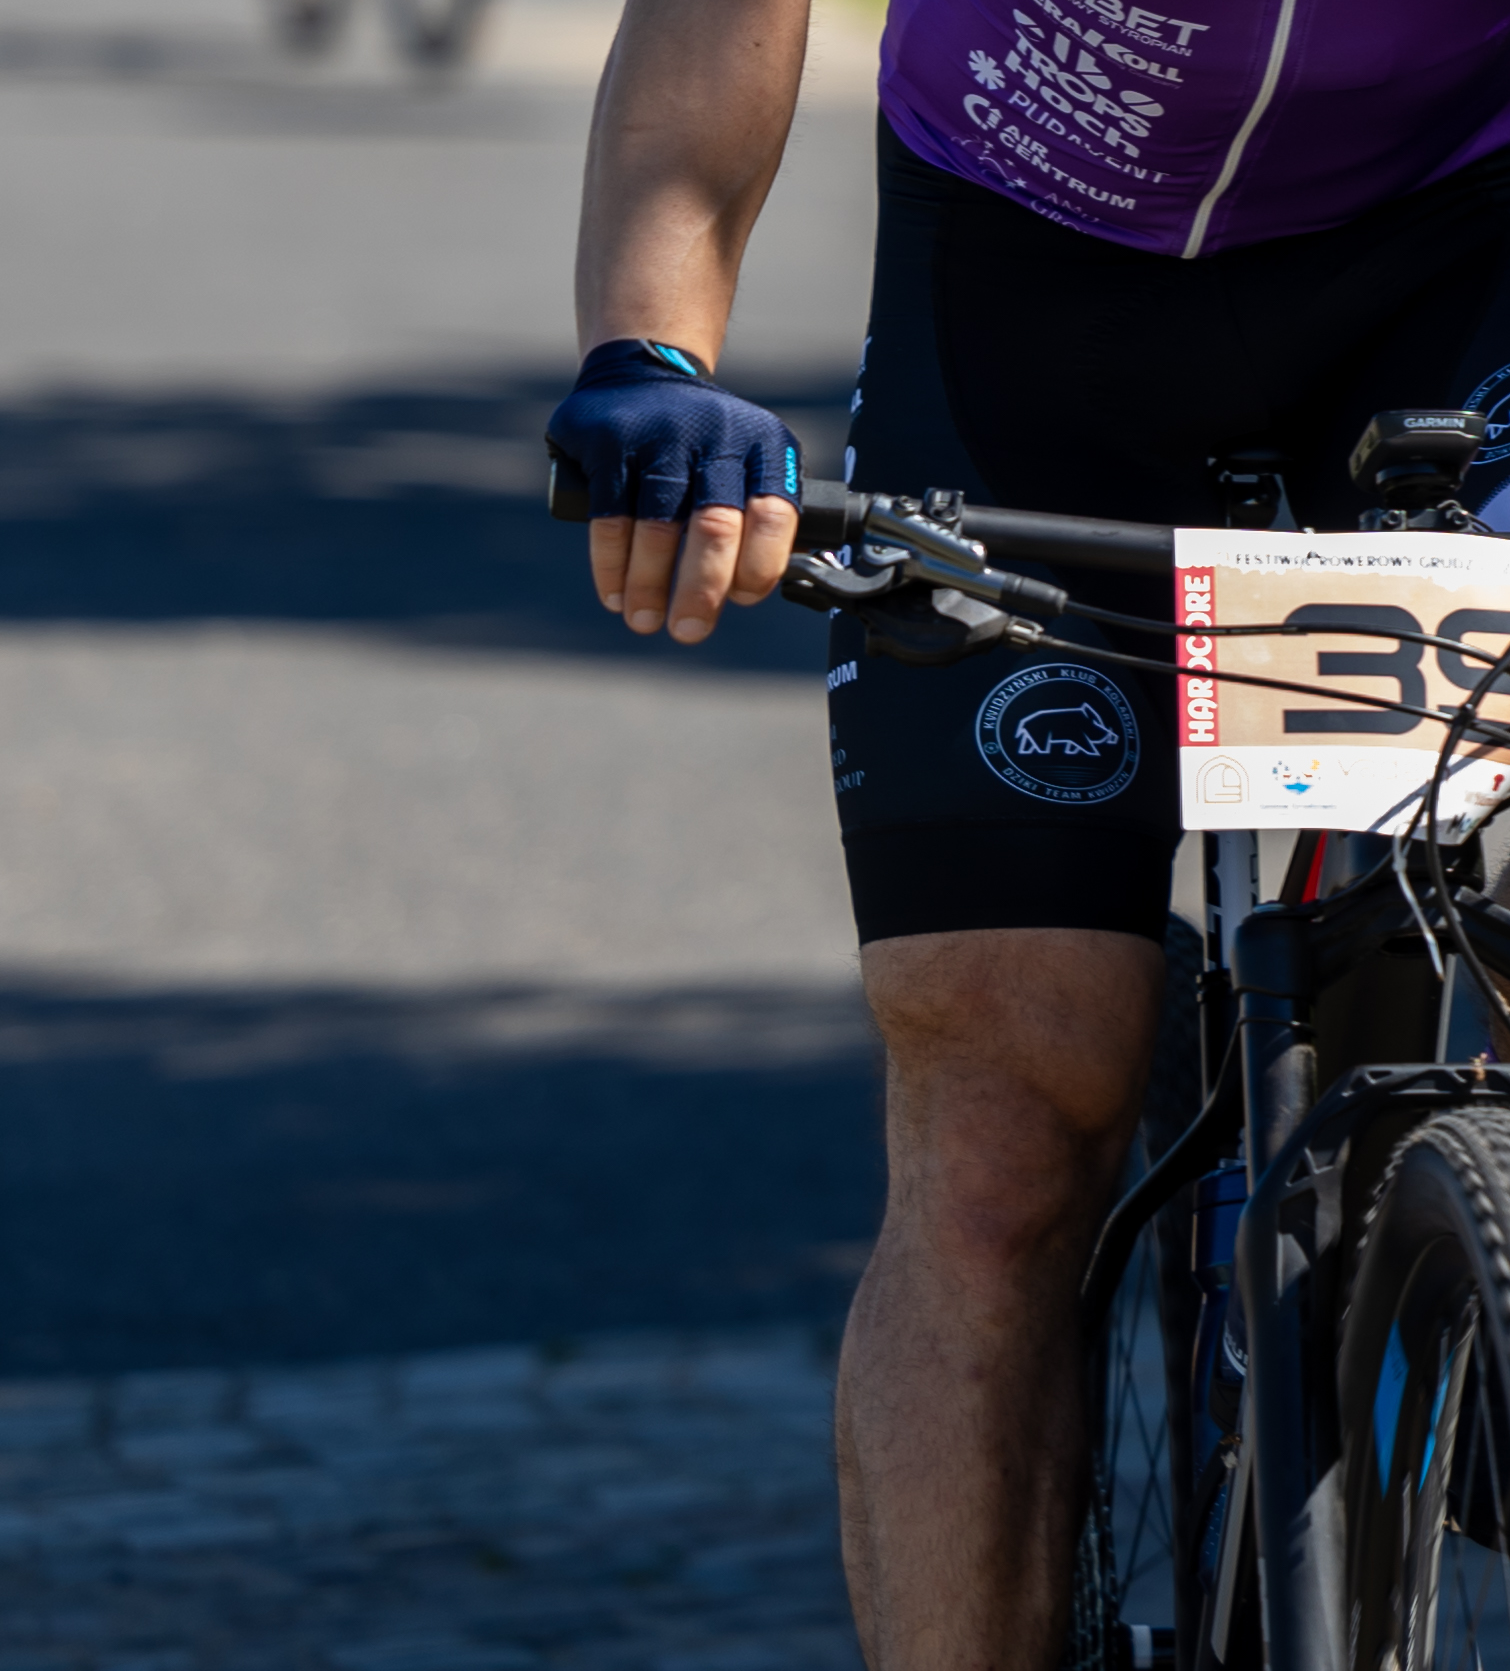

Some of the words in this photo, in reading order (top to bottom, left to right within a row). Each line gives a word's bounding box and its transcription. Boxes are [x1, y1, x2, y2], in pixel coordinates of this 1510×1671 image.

[1098, 15, 1193, 57] STYROPIAN
[1015, 28, 1152, 138] TROPS
[1002, 125, 1049, 160] AIR
[998, 132, 1137, 211] CENTRUM
[1404, 417, 1465, 429] GARMIN
[1060, 668, 1098, 684] KLUB
[1002, 767, 1039, 792] DZIKI
[1045, 787, 1083, 800] TEAM
